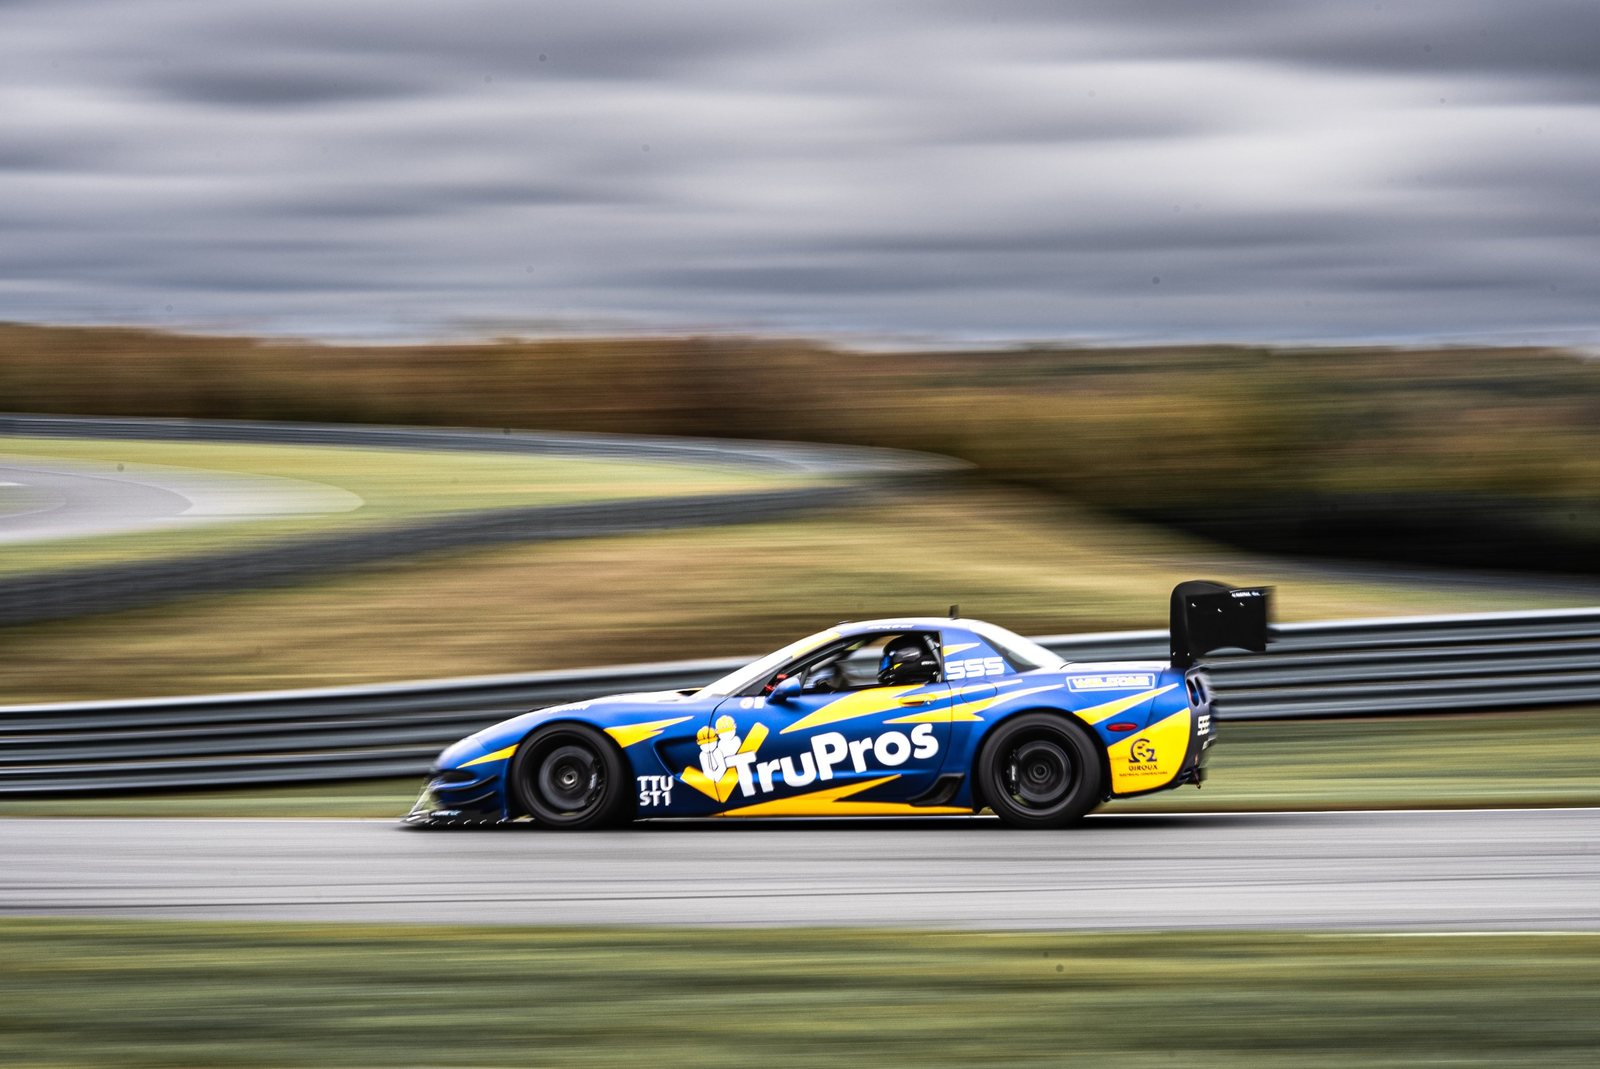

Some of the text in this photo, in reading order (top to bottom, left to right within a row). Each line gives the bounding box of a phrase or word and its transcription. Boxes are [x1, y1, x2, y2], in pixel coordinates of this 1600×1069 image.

[724, 723, 939, 797] TruPros
[636, 775, 675, 791] TTU
[639, 790, 672, 807] ST1
